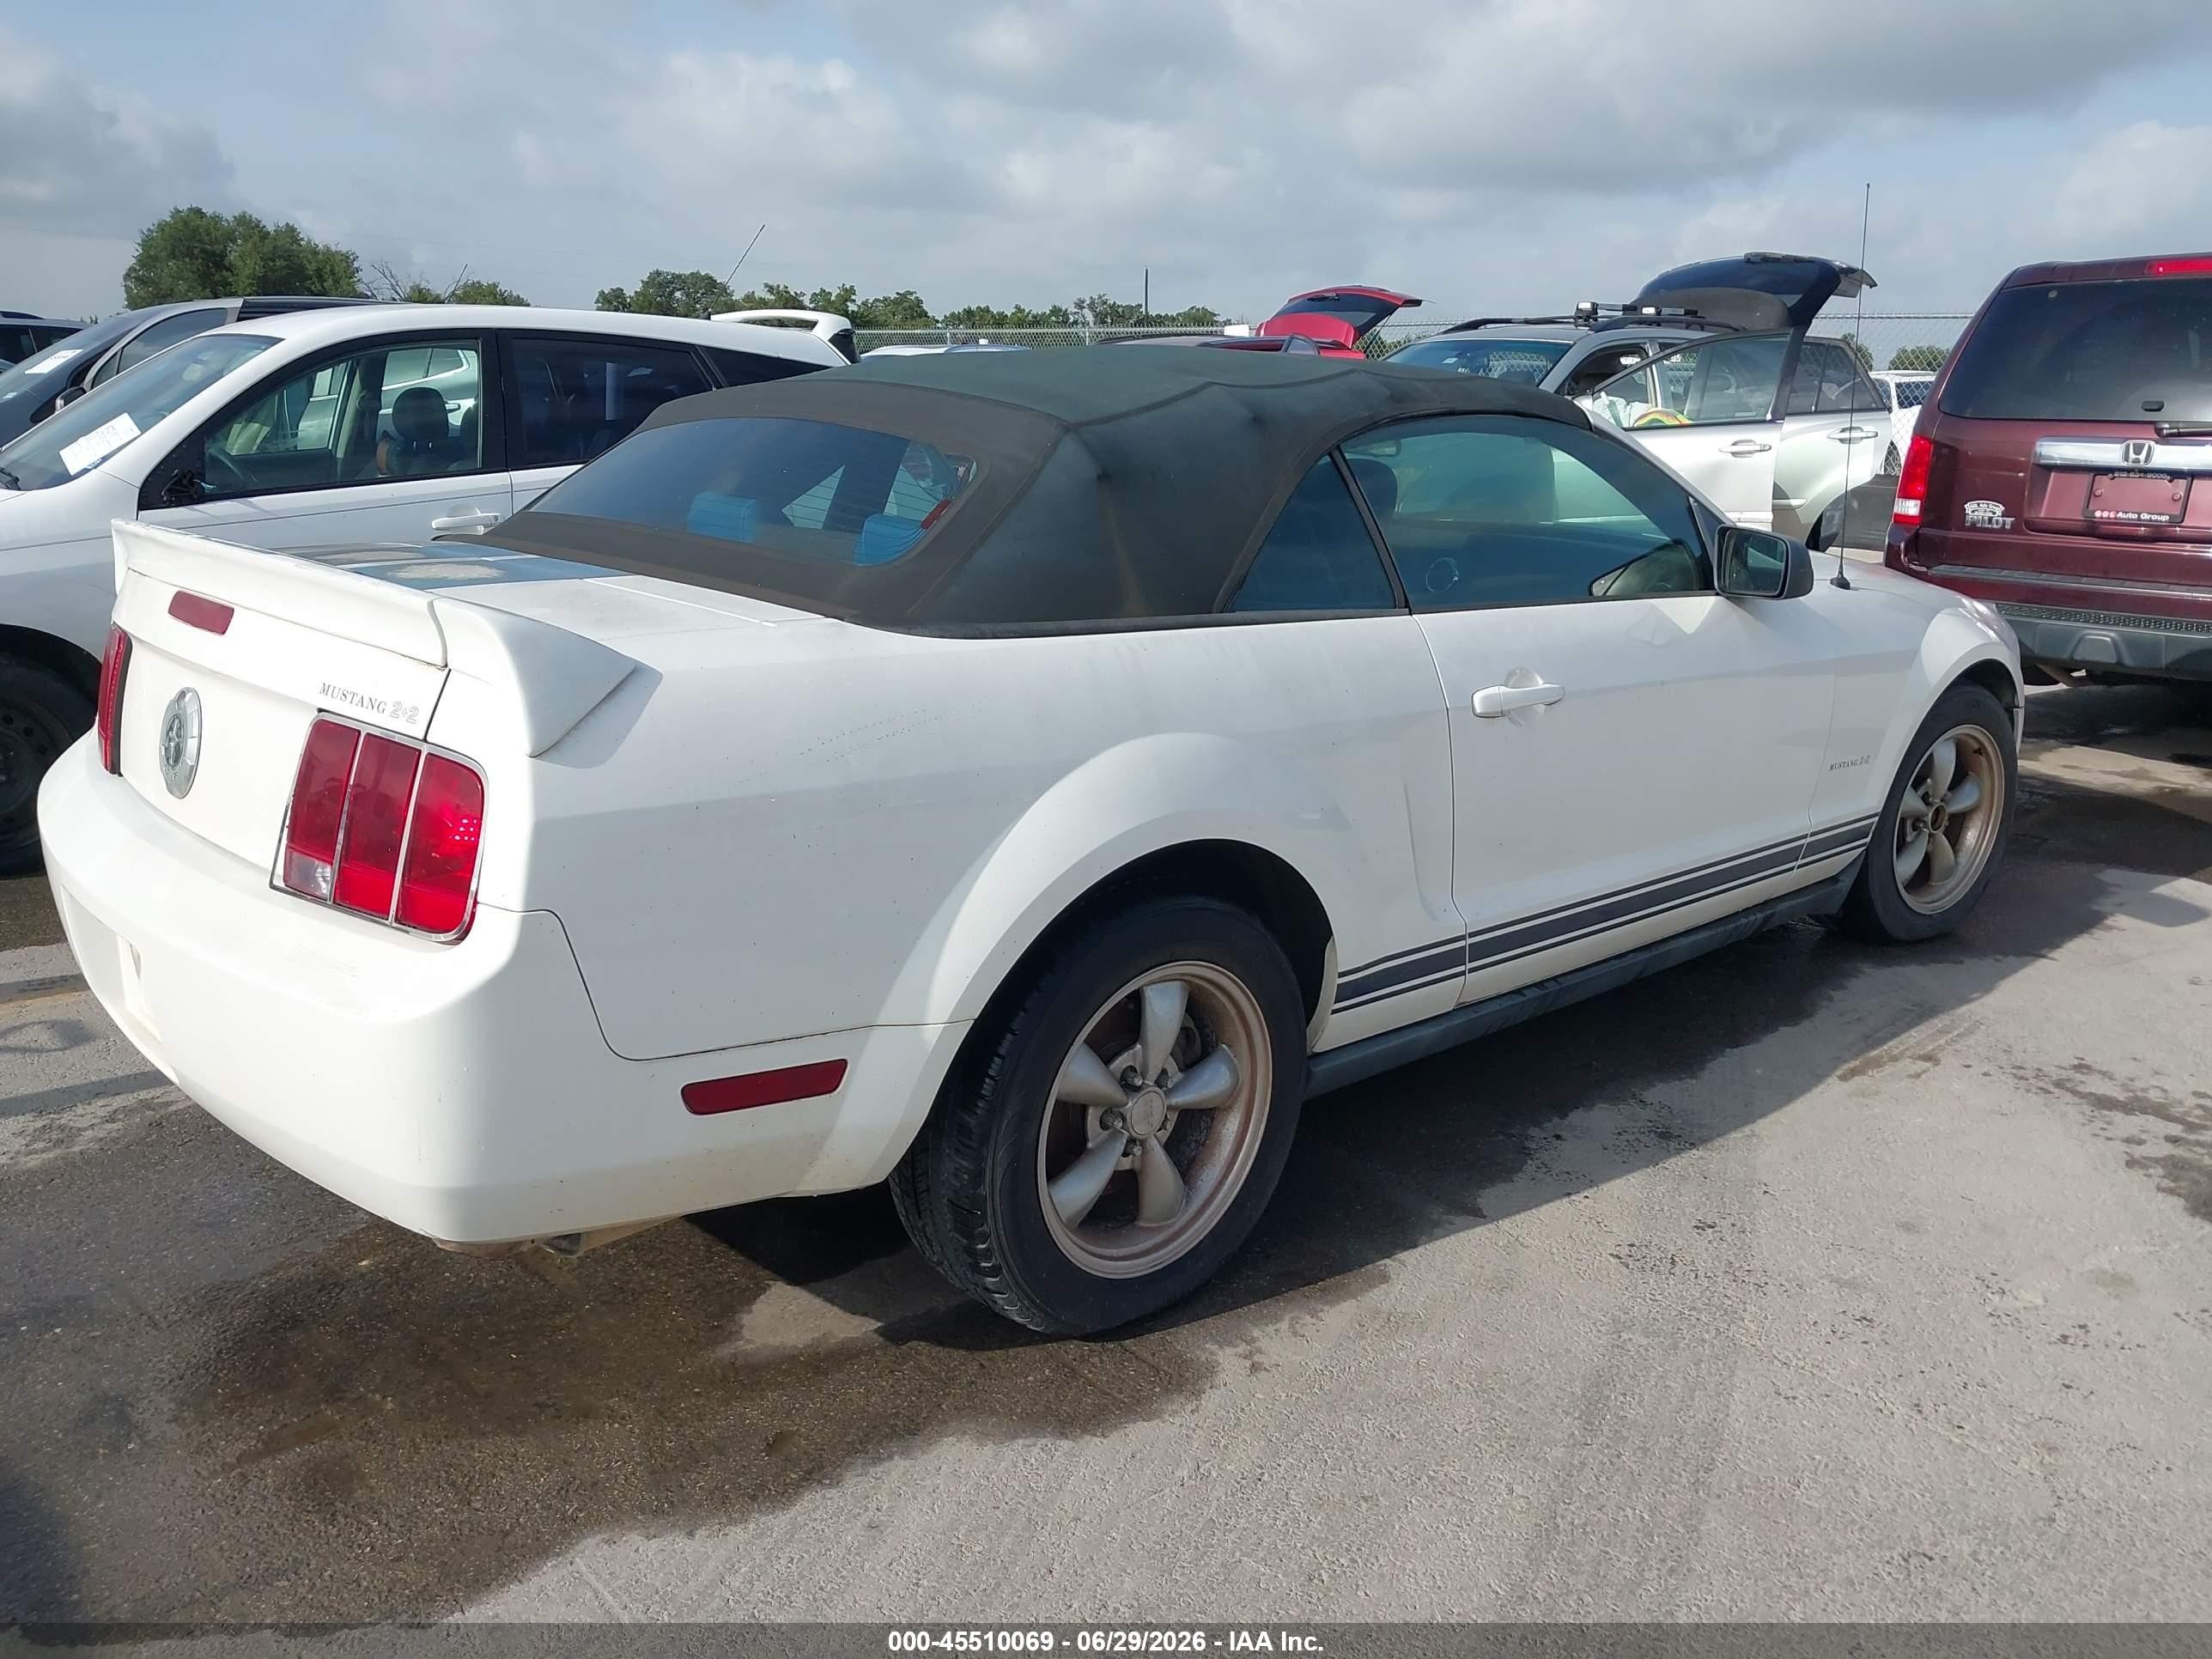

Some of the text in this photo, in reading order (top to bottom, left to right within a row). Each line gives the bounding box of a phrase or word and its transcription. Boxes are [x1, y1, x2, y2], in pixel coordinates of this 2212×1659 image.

[1965, 514, 2016, 529] PILOT
[2140, 512, 2169, 522] Group
[319, 683, 386, 714] MUSTANG
[1828, 758, 1859, 771] MUSTANG
